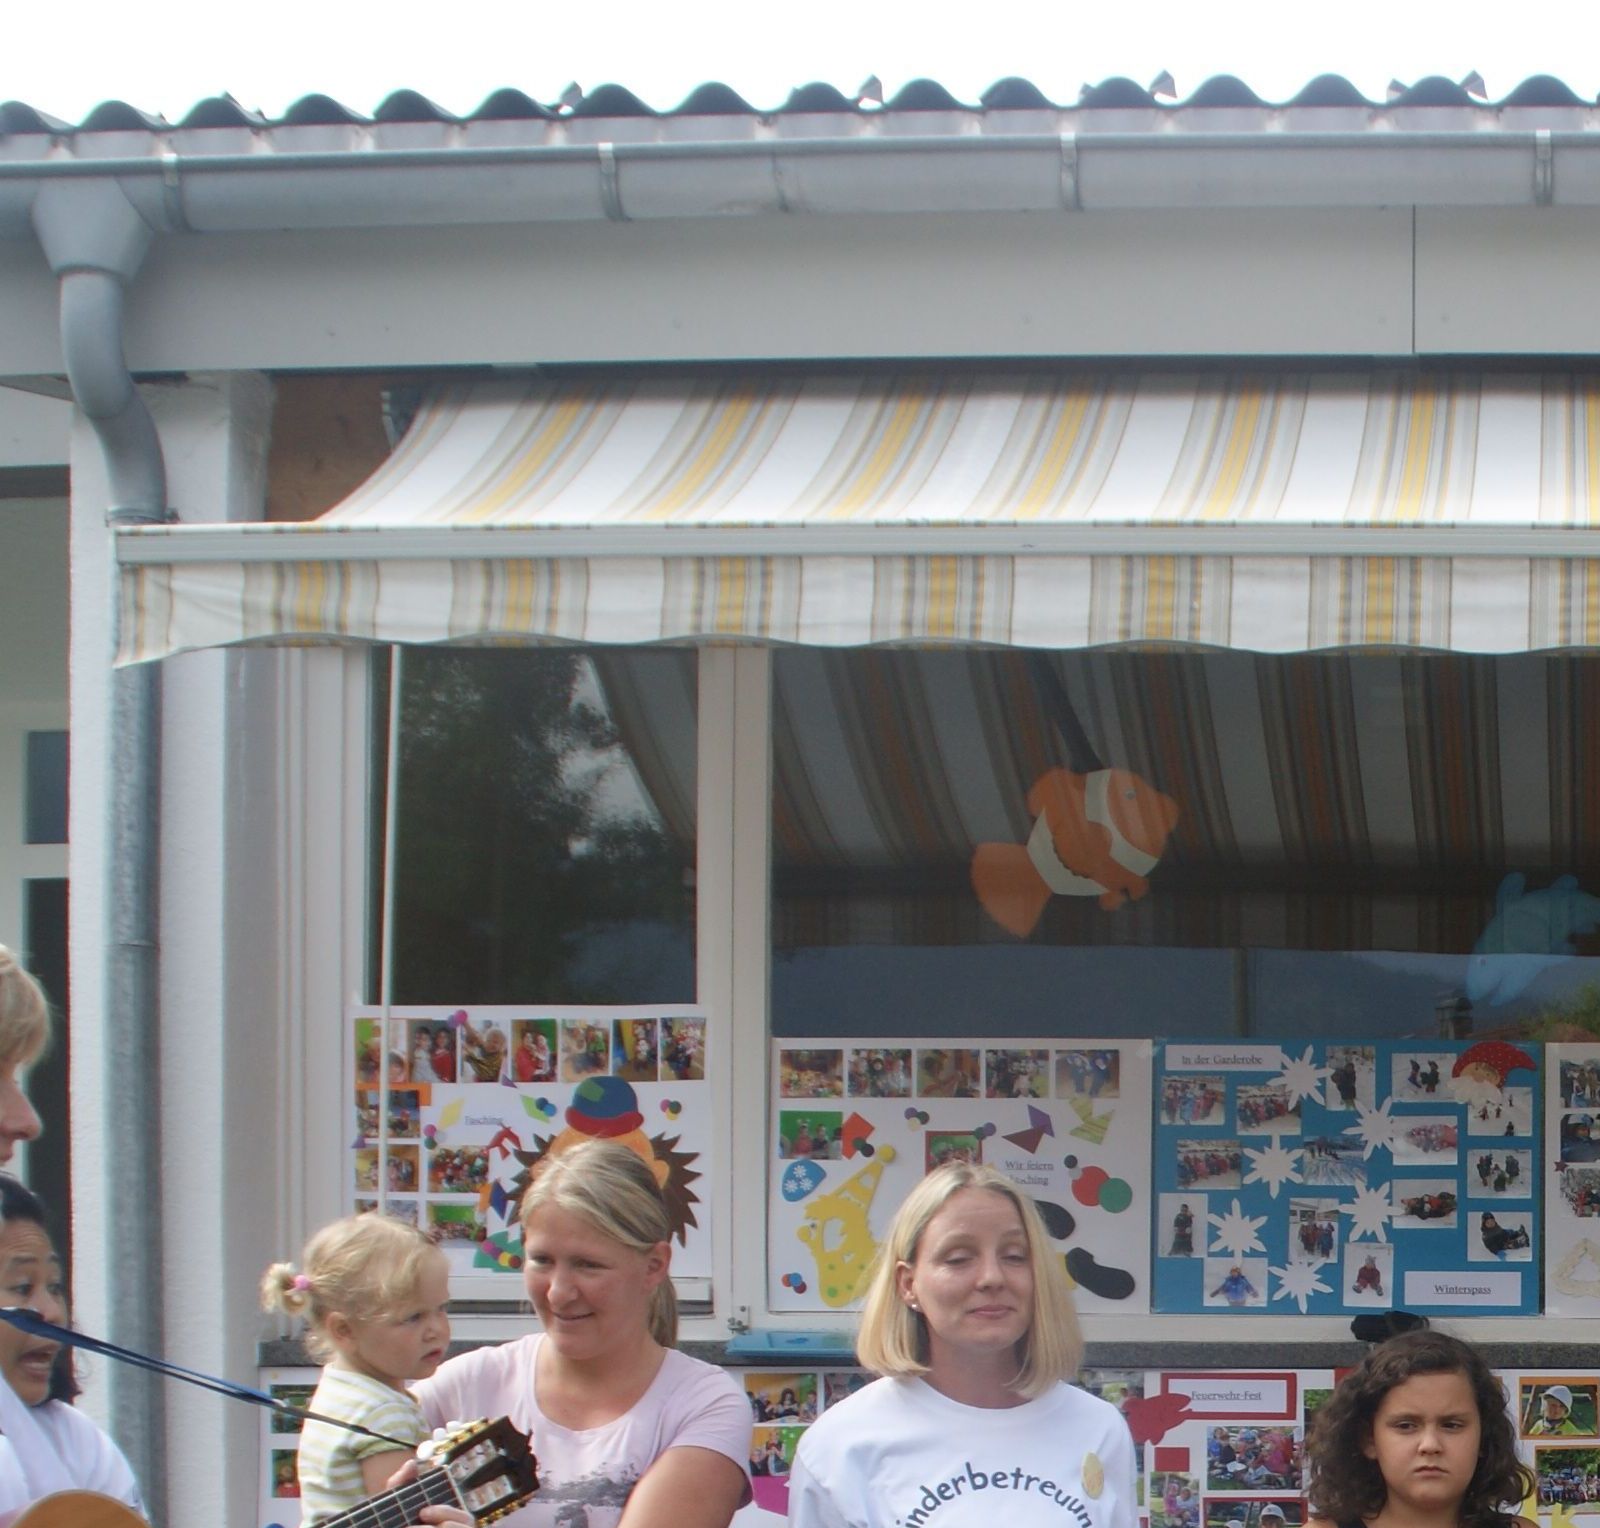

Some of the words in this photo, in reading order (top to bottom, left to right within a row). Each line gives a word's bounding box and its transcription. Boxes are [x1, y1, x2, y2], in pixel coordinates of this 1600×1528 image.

[1182, 1055, 1191, 1065] In
[1194, 1054, 1209, 1065] der
[1213, 1053, 1262, 1065] Garderobe
[1005, 1160, 1024, 1170] Wir
[1027, 1159, 1054, 1171] feiern
[1433, 1284, 1492, 1296] Winterspass
[1191, 1390, 1262, 1401] Feuerwehr-Fest
